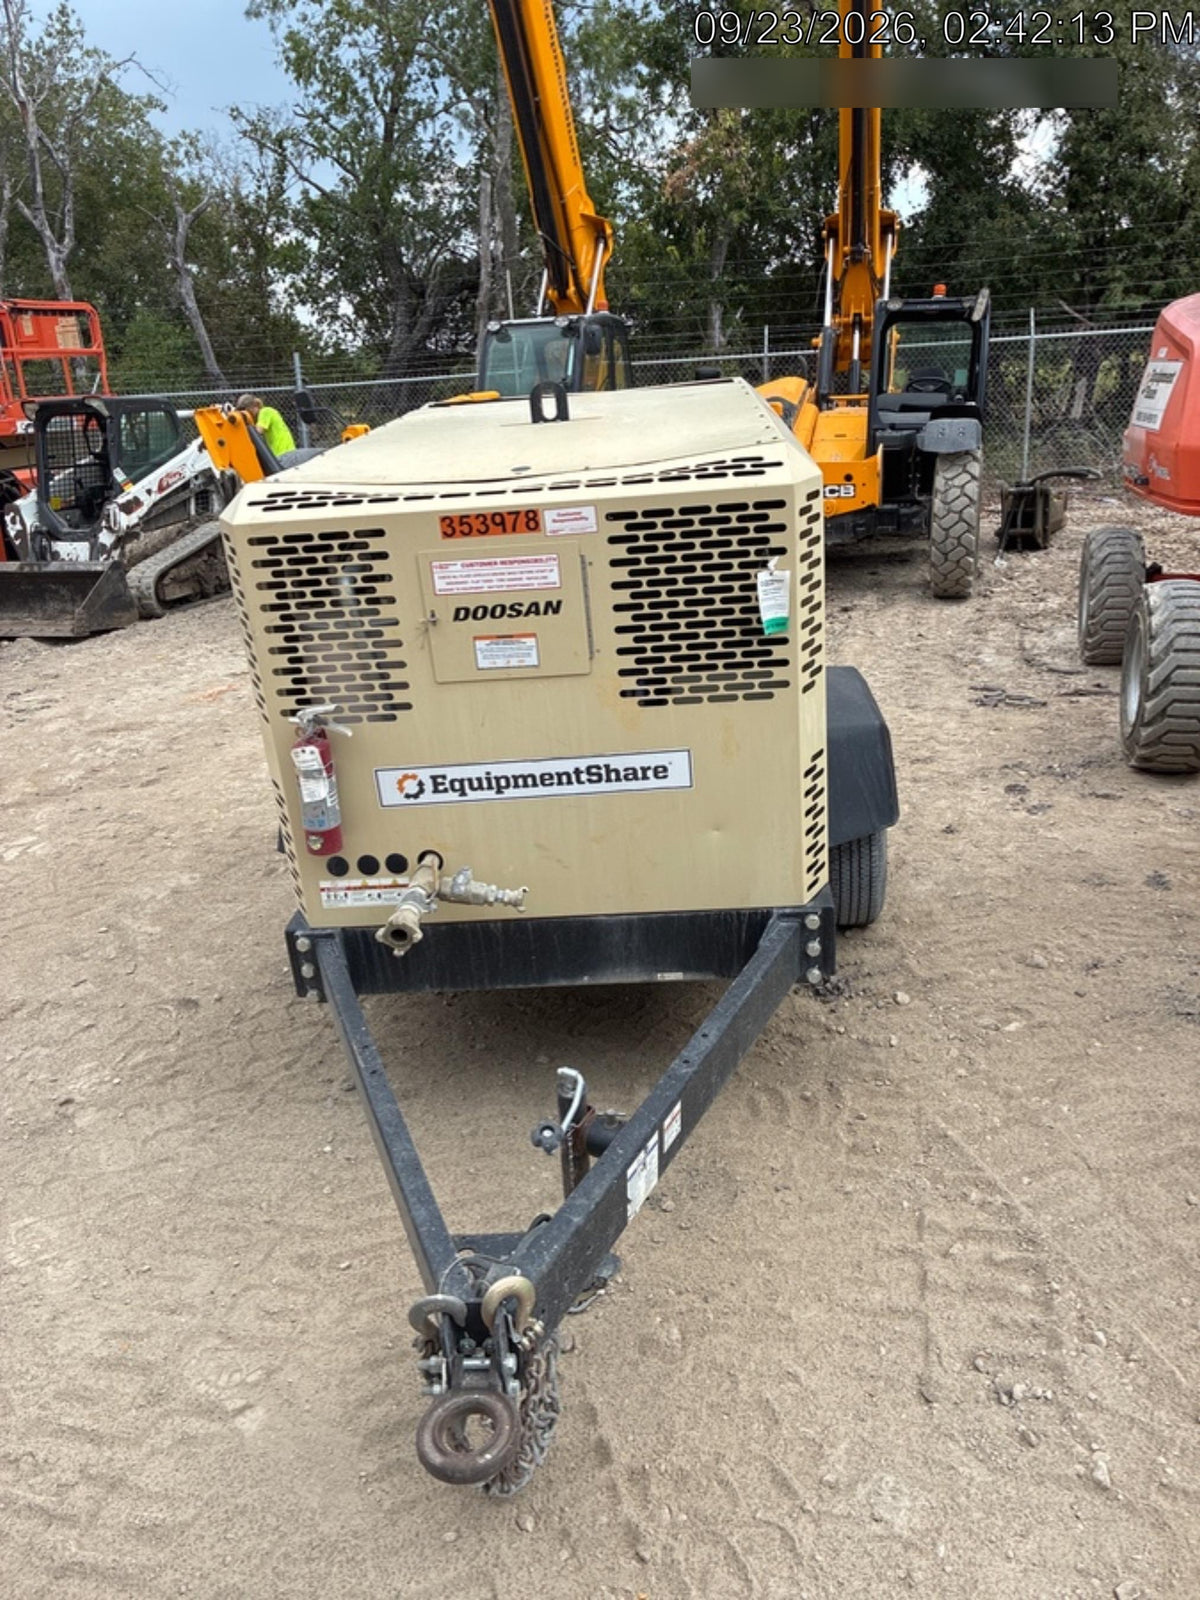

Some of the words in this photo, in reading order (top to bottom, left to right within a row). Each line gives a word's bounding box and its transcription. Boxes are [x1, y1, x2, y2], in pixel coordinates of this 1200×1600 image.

[824, 485, 855, 498] CB
[440, 509, 540, 538] 353978
[452, 600, 563, 622] DOOSAN
[429, 762, 670, 797] EquipmentShare
